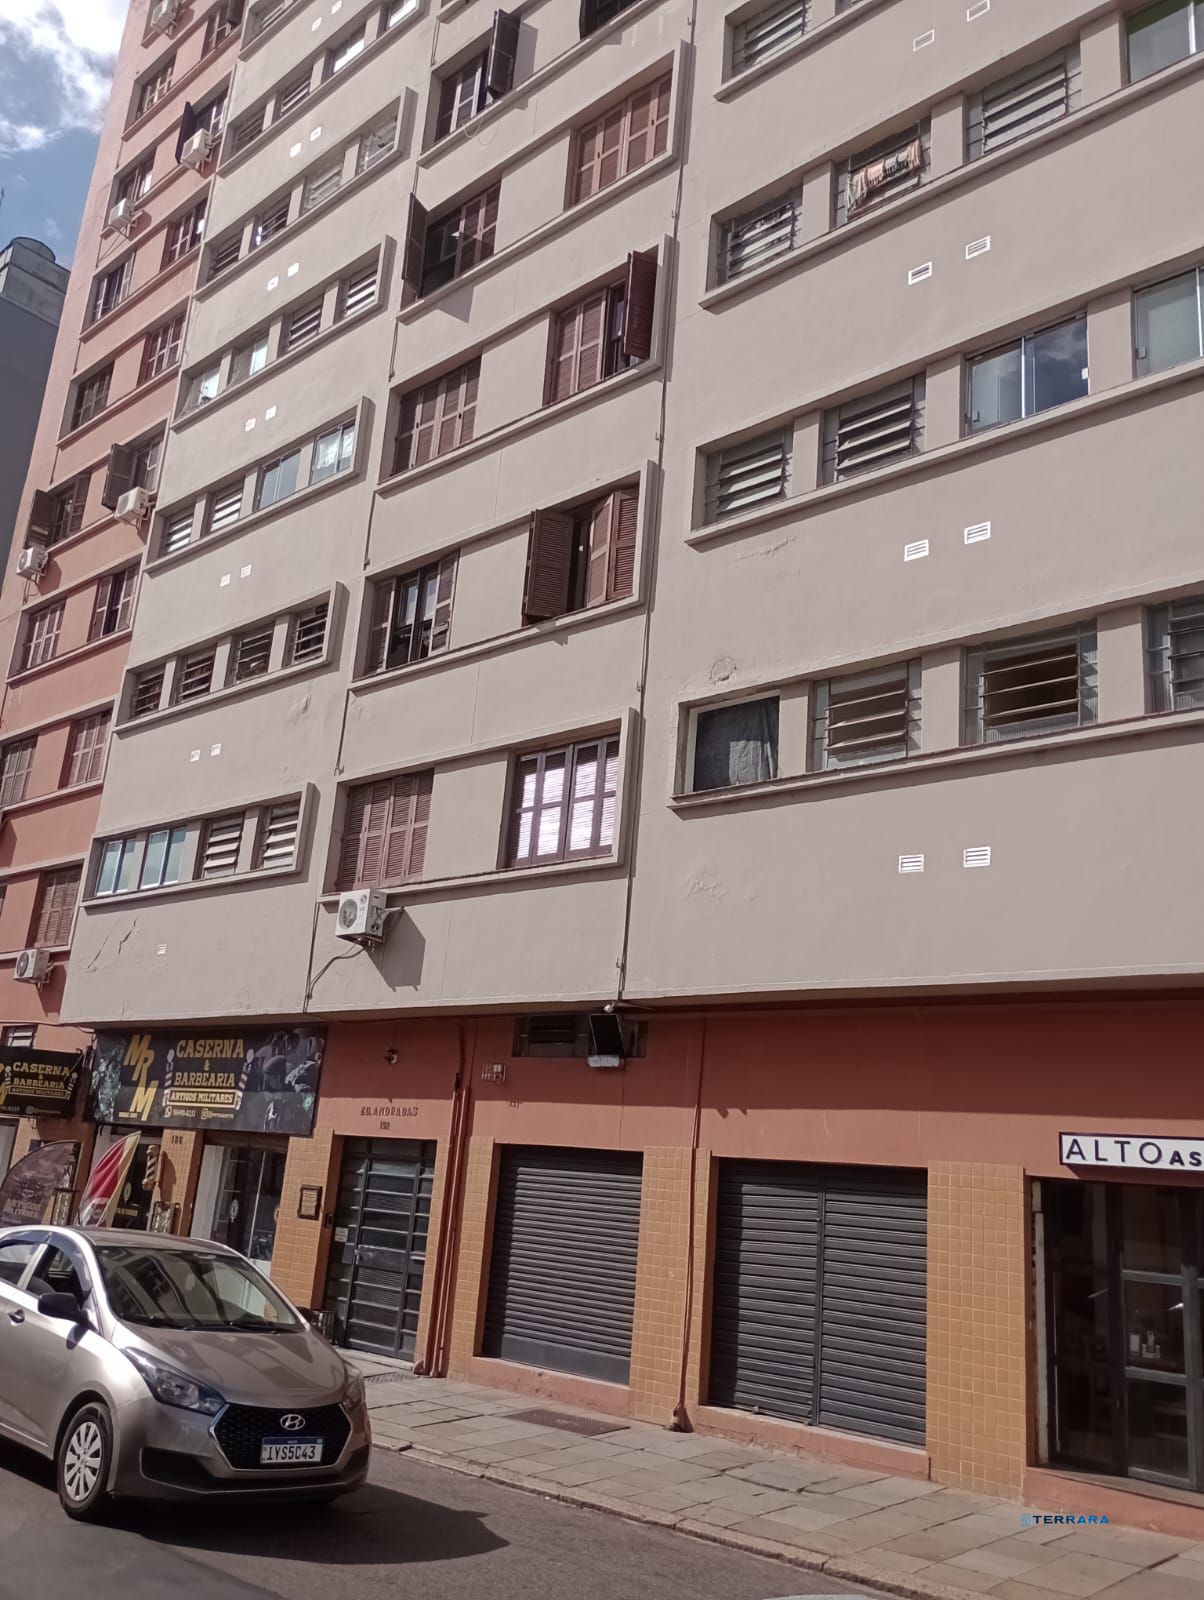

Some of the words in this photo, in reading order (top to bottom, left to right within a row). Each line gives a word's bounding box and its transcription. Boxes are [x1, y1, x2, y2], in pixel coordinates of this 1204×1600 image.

[176, 1039, 244, 1058] CASERNA
[13, 1061, 70, 1076] CASERNA
[13, 1077, 65, 1089] BARBEARIA
[174, 1072, 235, 1087] BARBEARIA
[198, 1092, 234, 1104] MILITARES
[1065, 1138, 1163, 1165] ALTO
[266, 1445, 317, 1461] IYS5C43
